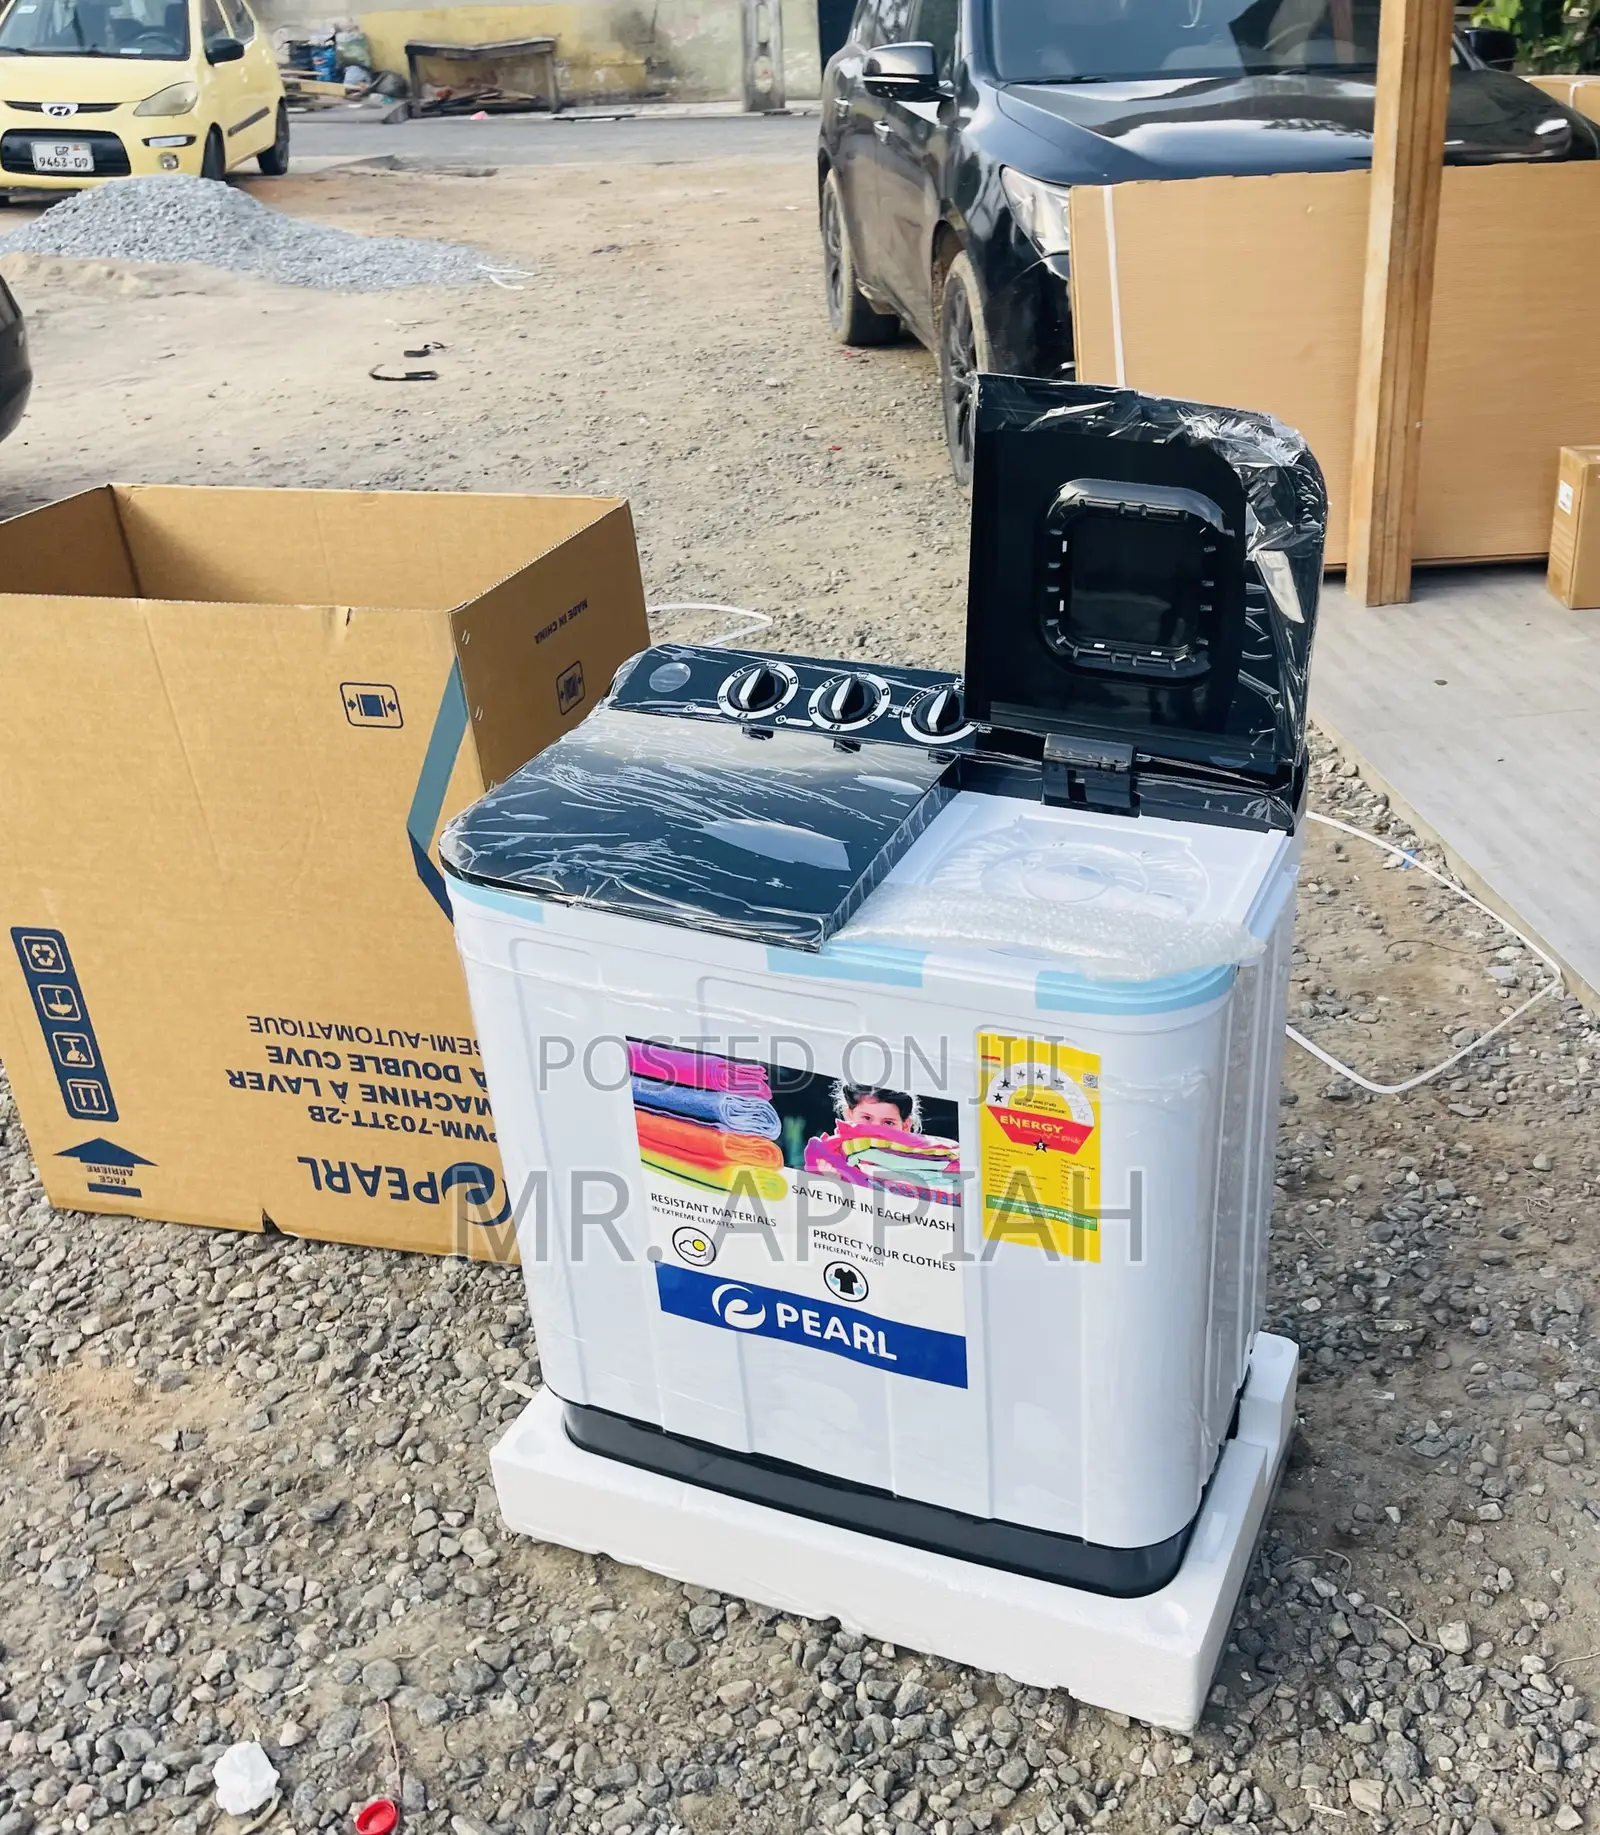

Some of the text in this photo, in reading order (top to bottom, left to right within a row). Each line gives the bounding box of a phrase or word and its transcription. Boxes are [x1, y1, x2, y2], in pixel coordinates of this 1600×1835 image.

[534, 598, 588, 644] MADE IN CHINA
[265, 1045, 341, 1070] CUVE
[347, 1053, 462, 1084] DOUBLE
[225, 1069, 493, 1117] MACHINE À LAVER
[1000, 1114, 1064, 1133] ENERGY
[98, 1175, 126, 1185] FACE
[297, 1156, 440, 1204] PEARL
[650, 1193, 777, 1227] RESISTANT MATERIALS
[661, 1208, 695, 1221] EXTREME
[697, 1216, 735, 1229] CLIMATES
[791, 1184, 956, 1232] SAVE TIME IN EACH WASH
[813, 1229, 956, 1272] PROTECT YOUR CLOTHES
[814, 1242, 884, 1267] EFFICIENTLY WASH
[775, 1302, 897, 1361] PEARL
